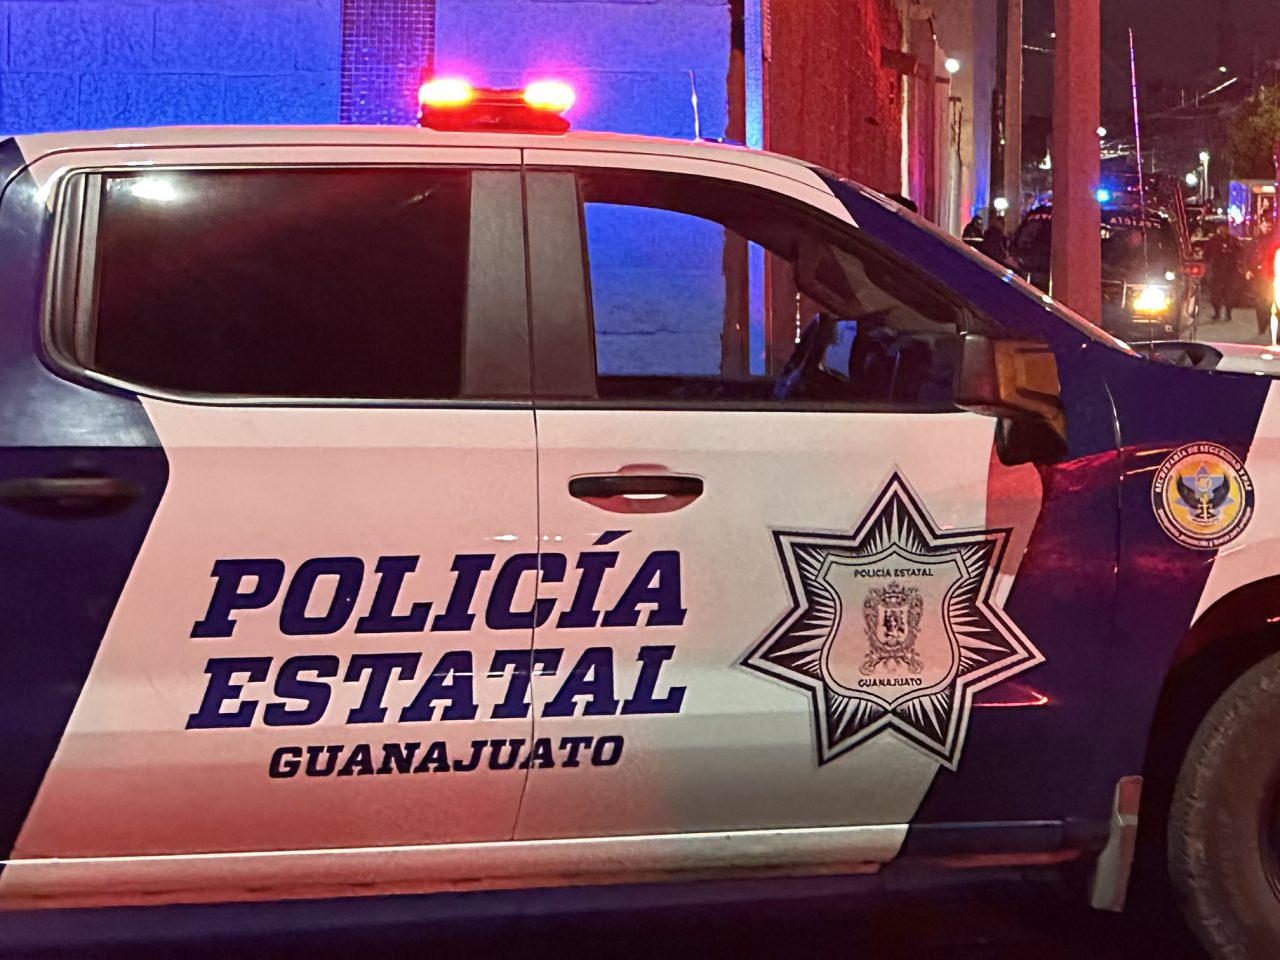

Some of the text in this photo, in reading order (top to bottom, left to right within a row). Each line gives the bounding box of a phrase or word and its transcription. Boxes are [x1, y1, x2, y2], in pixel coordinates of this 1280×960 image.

[1187, 445, 1199, 455] DE
[190, 529, 688, 639] POLICÍA
[854, 567, 934, 578] POLICÍA ESTATAL
[185, 645, 688, 731] ESTATAL
[858, 677, 923, 688] GUANAJUATO
[268, 735, 625, 779] GUANAJUATO
